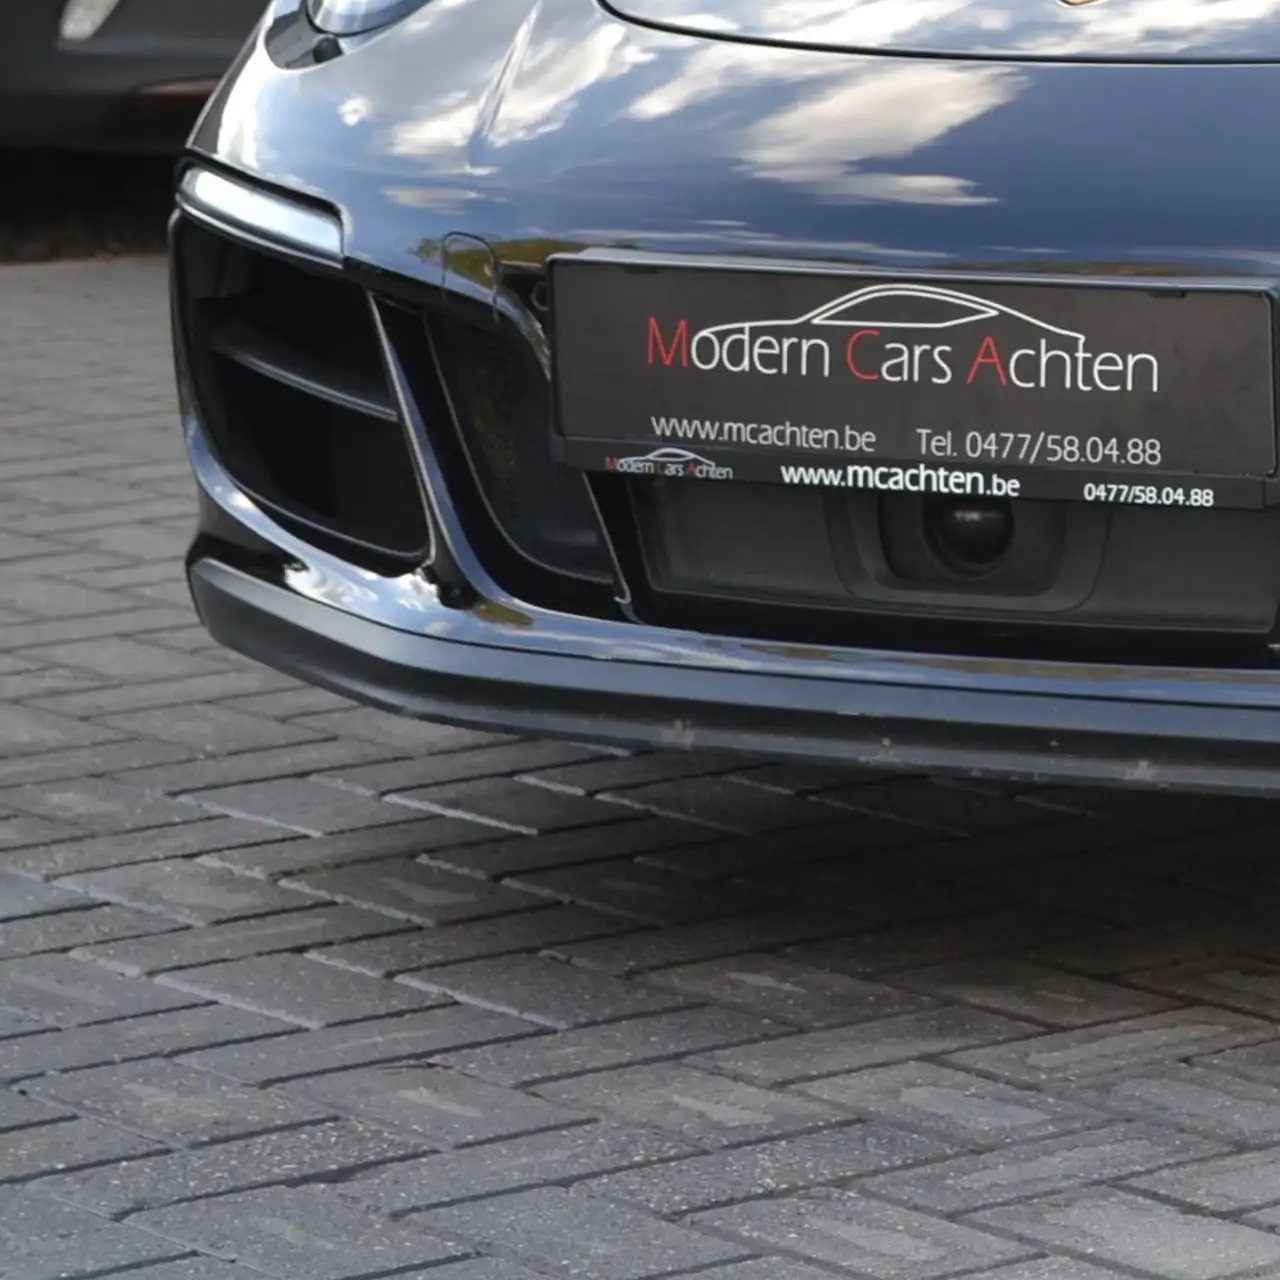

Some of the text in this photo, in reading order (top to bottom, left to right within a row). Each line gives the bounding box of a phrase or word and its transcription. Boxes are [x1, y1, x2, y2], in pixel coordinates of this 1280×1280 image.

[647, 316, 1159, 393] Modern Cars Achten
[650, 416, 1162, 466] www.mcachten.be Tel. 0477/58.04.88
[687, 463, 734, 480] Achten
[780, 463, 1022, 498] www.mcachten.be
[1082, 482, 1215, 508] 0477/58.04.88
